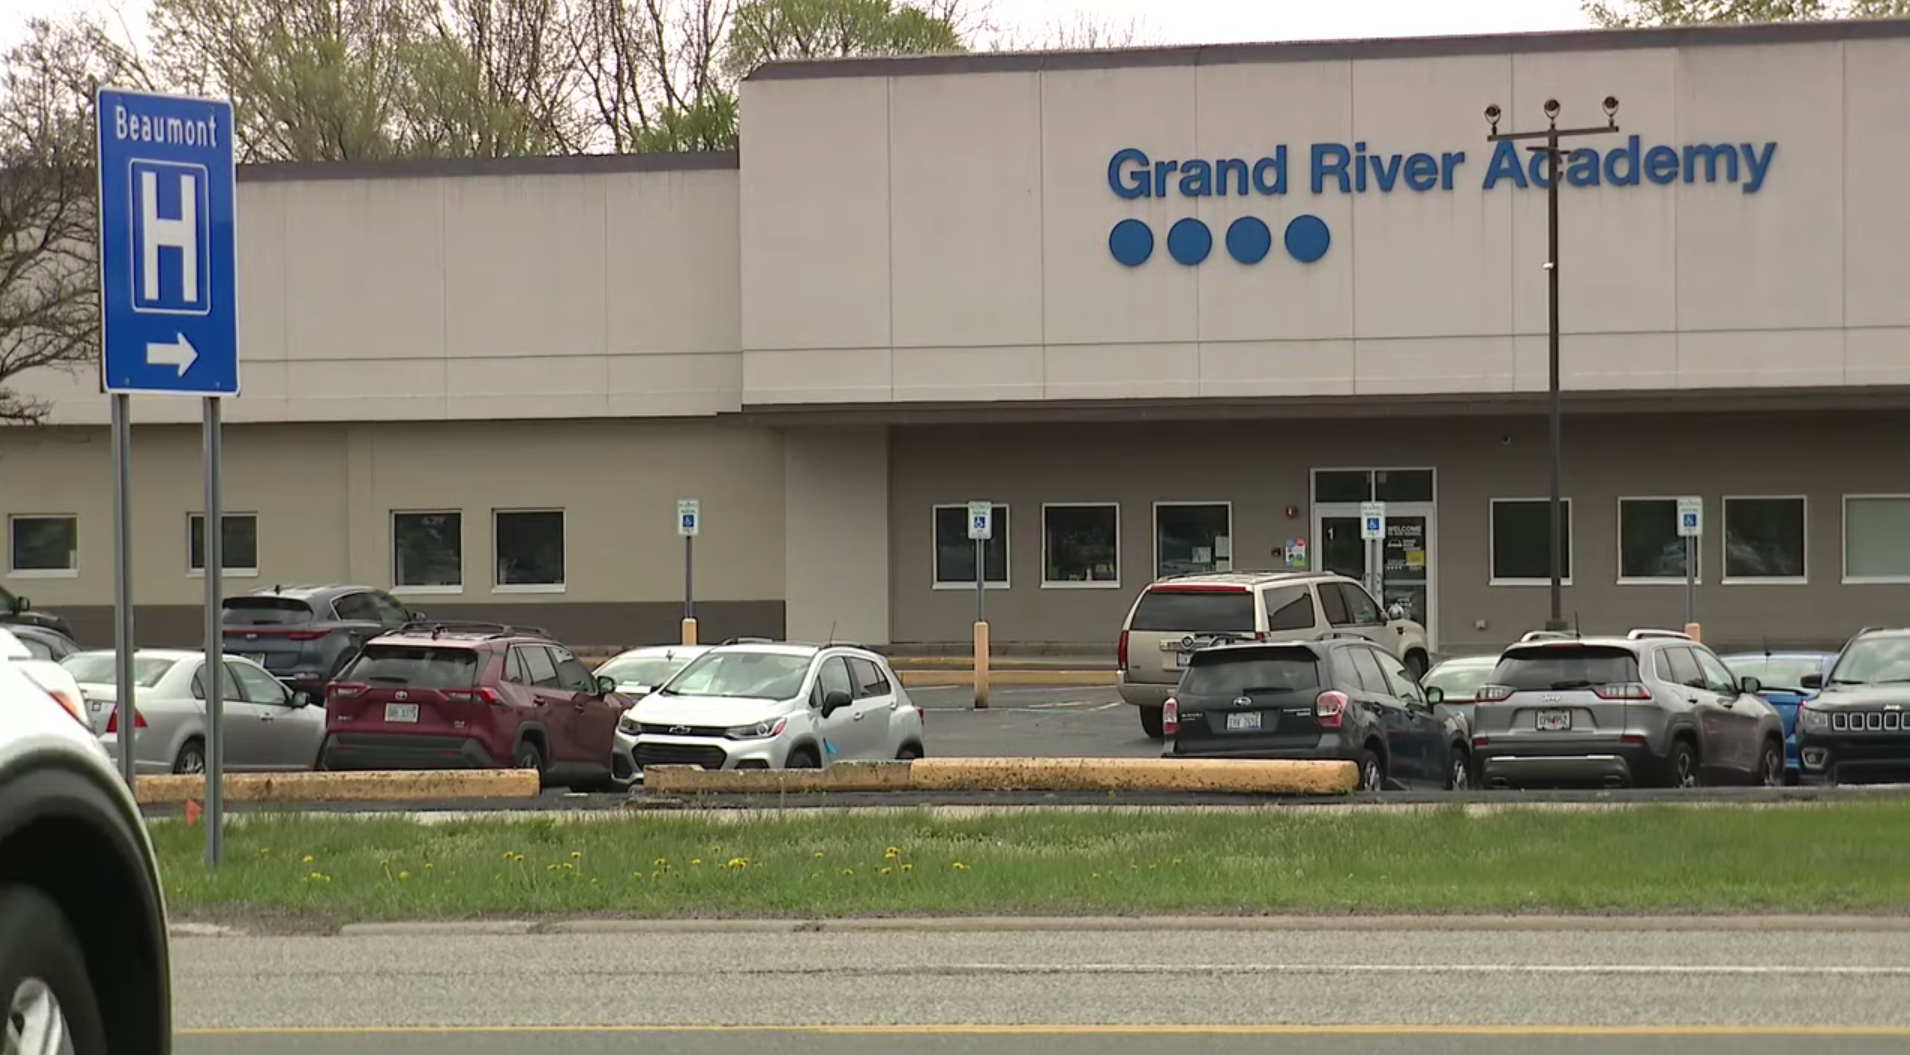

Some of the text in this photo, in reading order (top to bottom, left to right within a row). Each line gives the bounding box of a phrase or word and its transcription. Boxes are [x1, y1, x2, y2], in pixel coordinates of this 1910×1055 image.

[115, 105, 217, 147] Beaumont
[1107, 134, 1777, 199] Grand River Academy
[141, 171, 198, 303] H
[1327, 527, 1334, 540] 1
